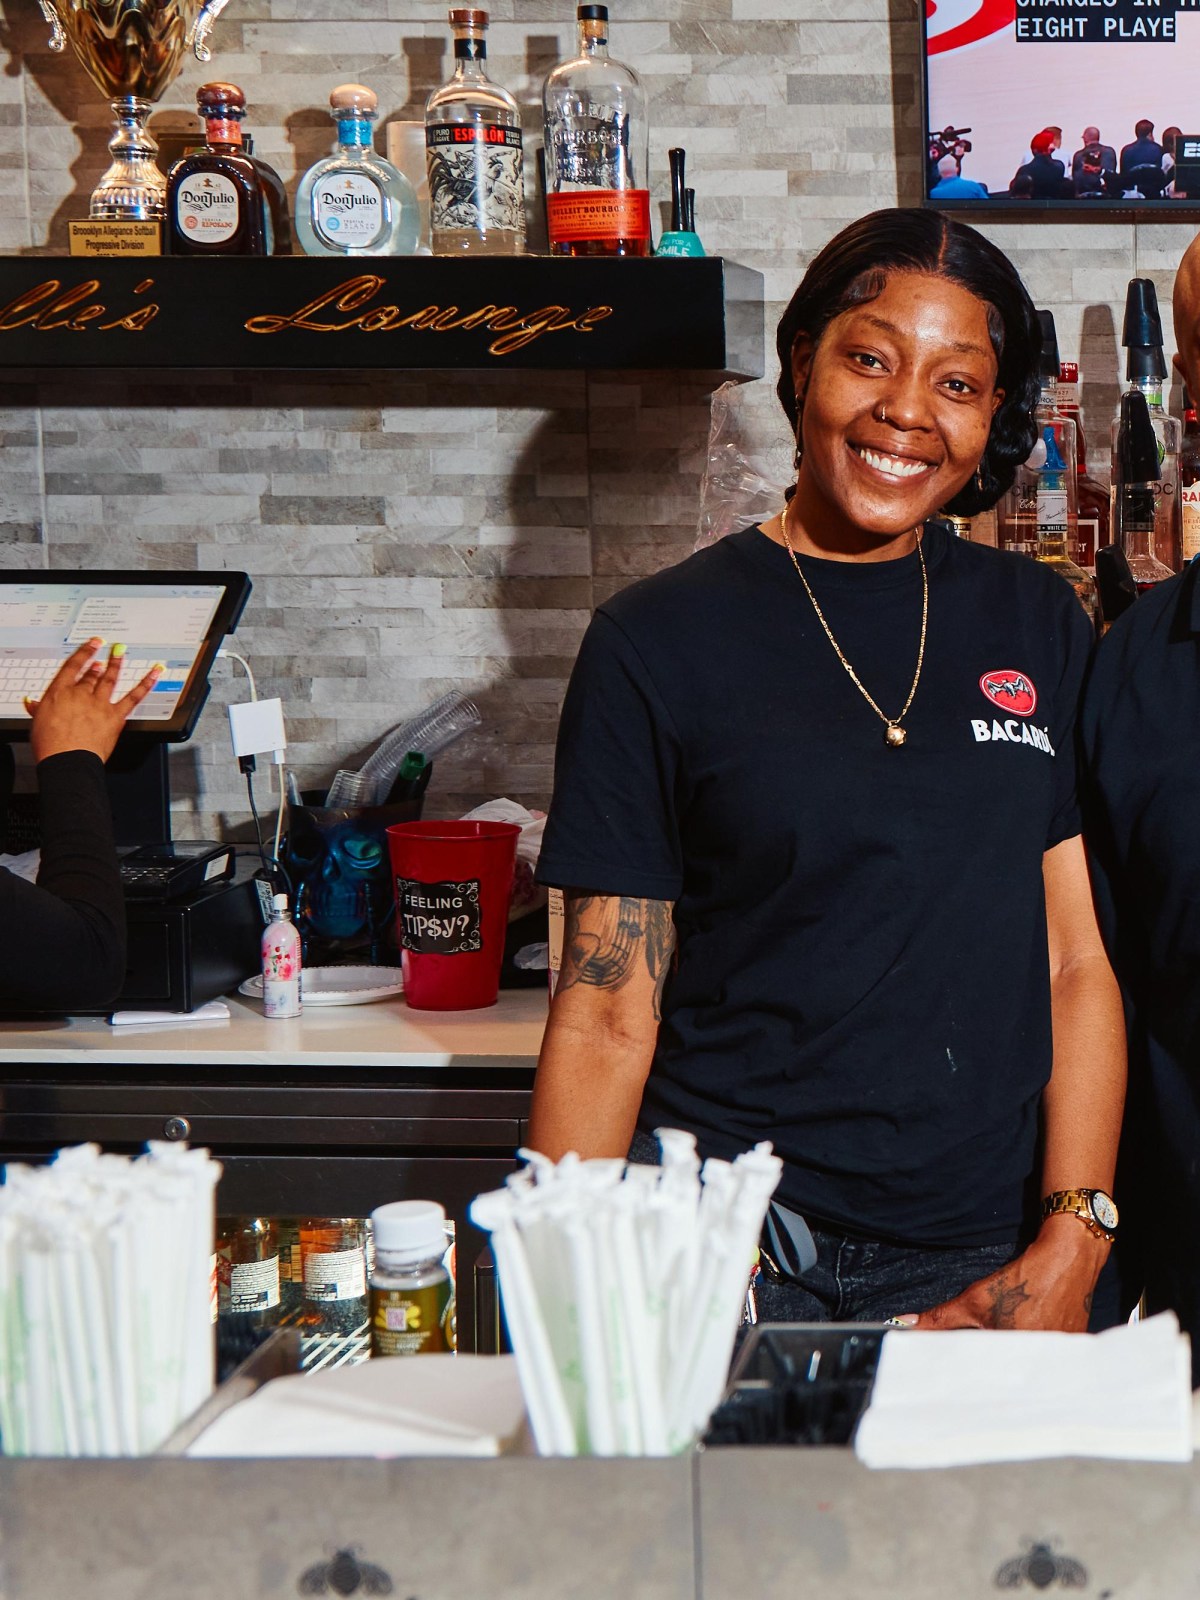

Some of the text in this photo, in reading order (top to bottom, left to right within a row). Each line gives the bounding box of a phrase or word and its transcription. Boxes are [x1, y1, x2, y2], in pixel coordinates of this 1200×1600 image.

[1017, 17, 1174, 37] EIGHT PLAYE
[583, 205, 626, 213] BOURBO
[103, 225, 133, 237] Allegiance
[134, 225, 156, 236] Softball
[85, 239, 145, 251] Progressive Division
[243, 274, 614, 354] Lounge
[405, 894, 463, 909] FEELING
